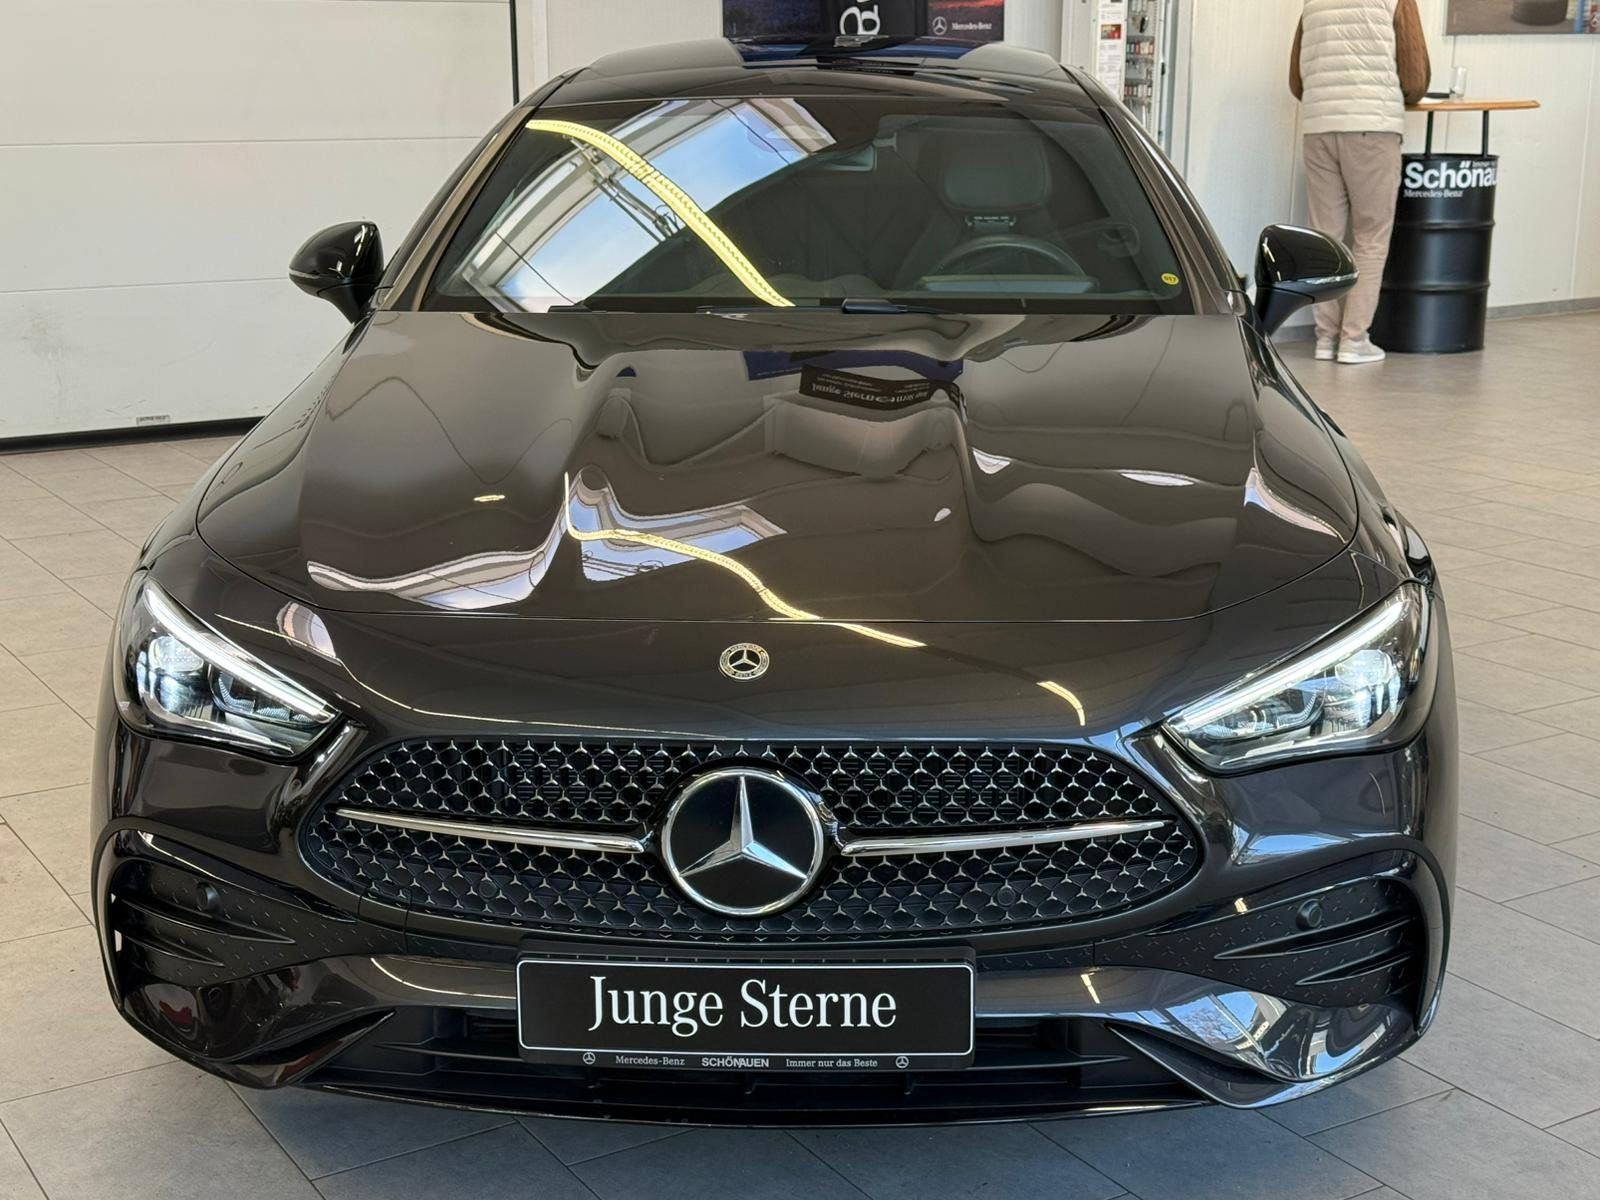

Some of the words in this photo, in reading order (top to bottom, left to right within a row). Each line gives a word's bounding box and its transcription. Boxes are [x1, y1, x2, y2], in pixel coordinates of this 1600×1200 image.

[951, 22, 992, 31] Mercedes-Benz
[1403, 189, 1464, 198] Mercedes-Benz
[588, 975, 723, 1037] Junge
[740, 979, 897, 1029] Sterne
[615, 1055, 685, 1066] Mercedes-Benz
[701, 1056, 769, 1068] SCHÖNAUEN
[786, 1058, 815, 1068] Immer
[818, 1060, 834, 1068] nur
[836, 1058, 852, 1068] das
[854, 1058, 878, 1068] Beste
